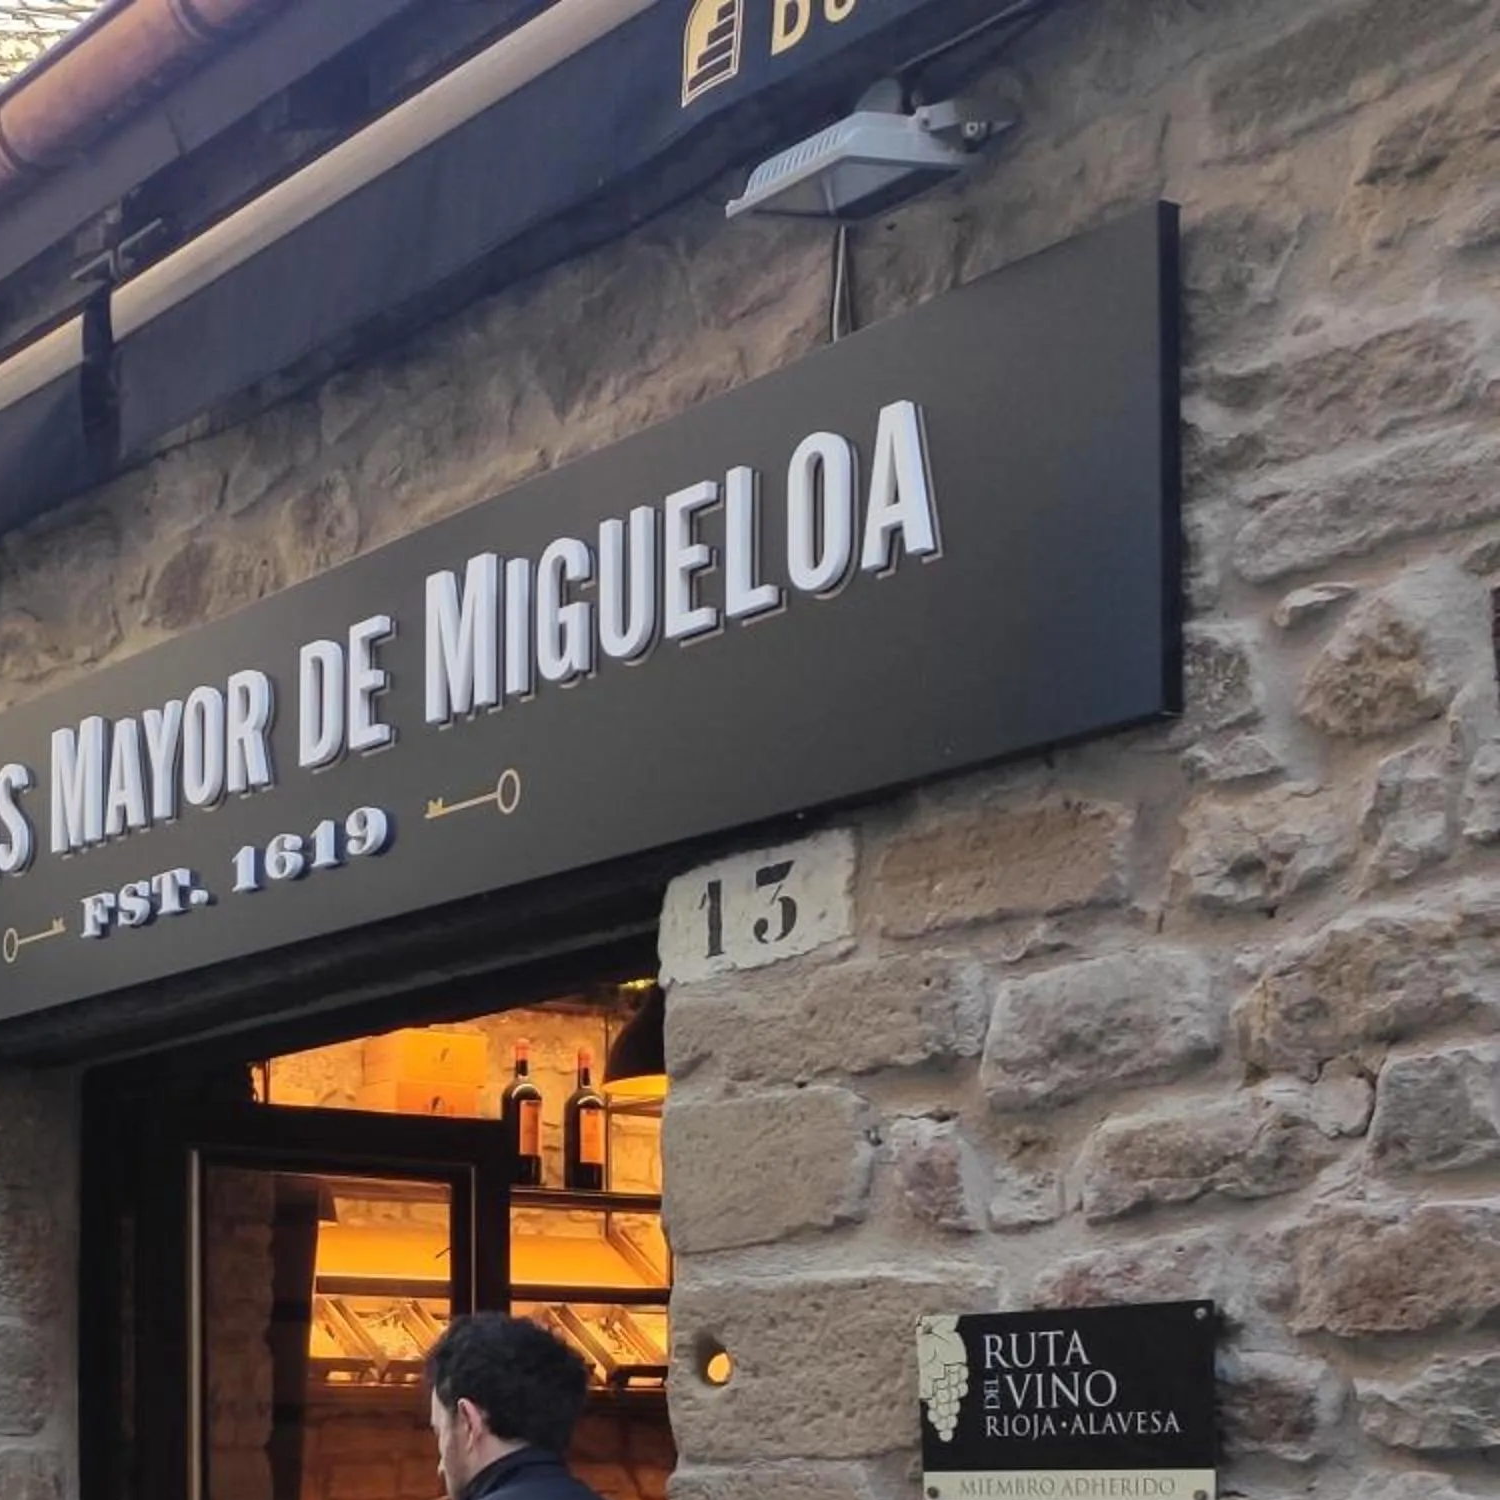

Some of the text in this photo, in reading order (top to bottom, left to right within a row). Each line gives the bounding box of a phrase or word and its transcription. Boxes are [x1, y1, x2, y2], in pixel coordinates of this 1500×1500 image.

[50, 669, 272, 854] MAYOR
[299, 614, 394, 768] DE
[425, 399, 937, 723] MIGUELOA
[231, 806, 388, 893] 1619
[699, 859, 798, 959] 13
[983, 1329, 1091, 1369] RUTA
[983, 1369, 1118, 1409] DEL VINO
[959, 1477, 1176, 1498] MIEMBRO ADHERIDO
